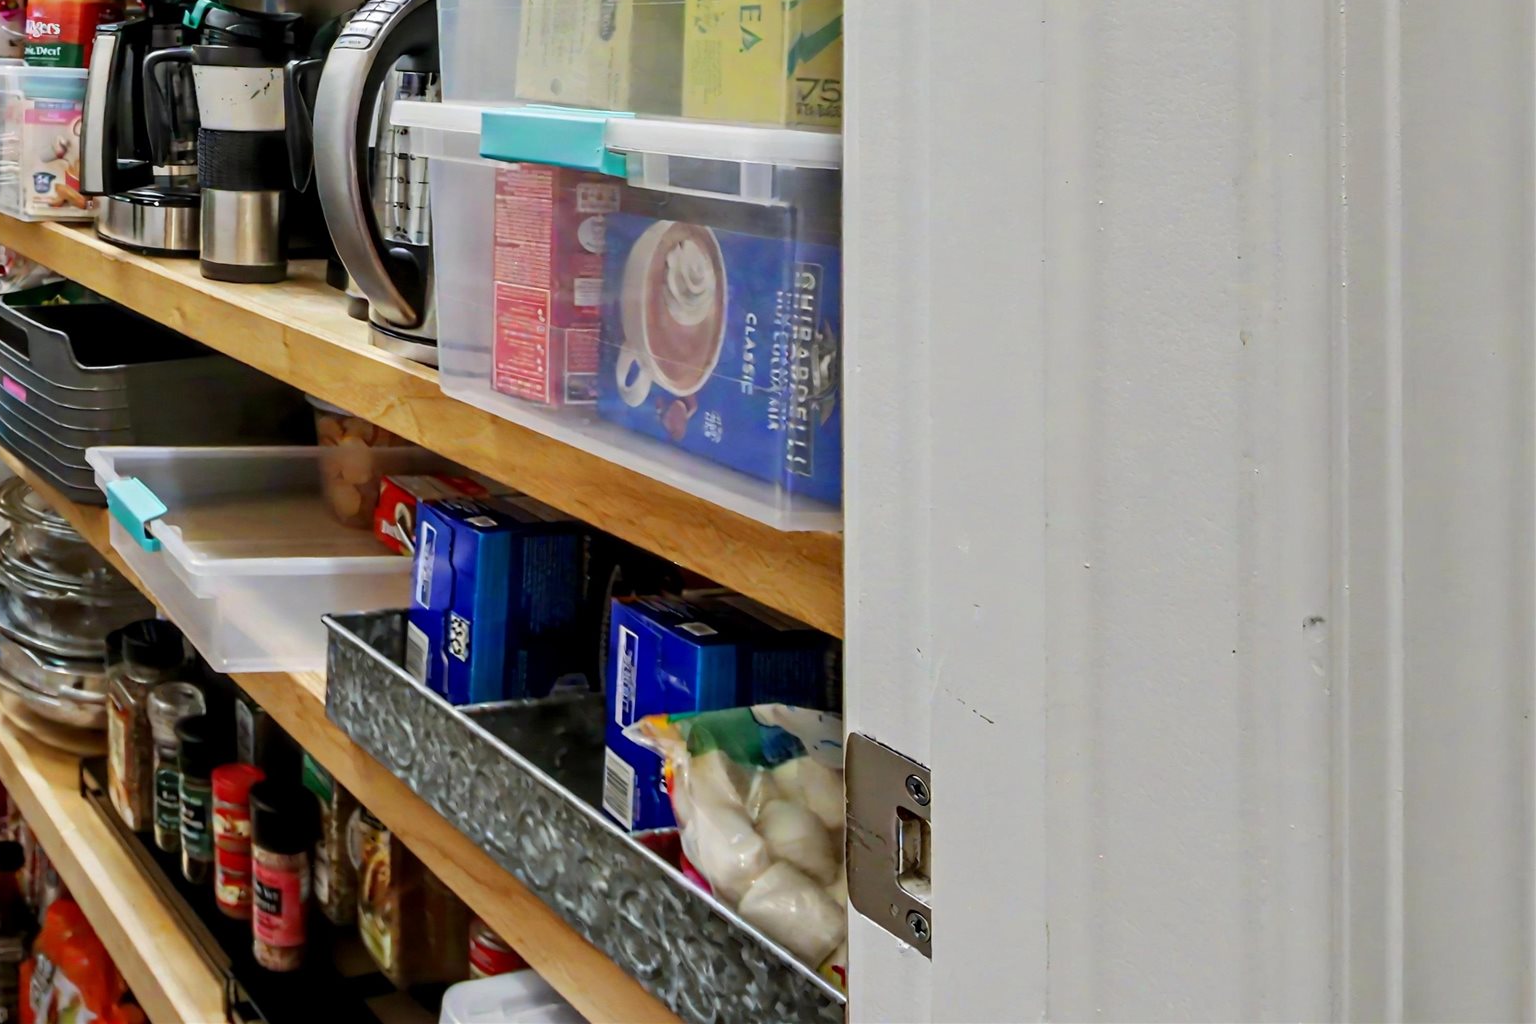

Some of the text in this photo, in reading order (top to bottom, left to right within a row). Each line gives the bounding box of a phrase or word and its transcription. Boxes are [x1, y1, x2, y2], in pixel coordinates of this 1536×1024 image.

[25, 19, 61, 38] lgers
[796, 77, 842, 103] 75
[741, 312, 758, 396] CLASSIC
